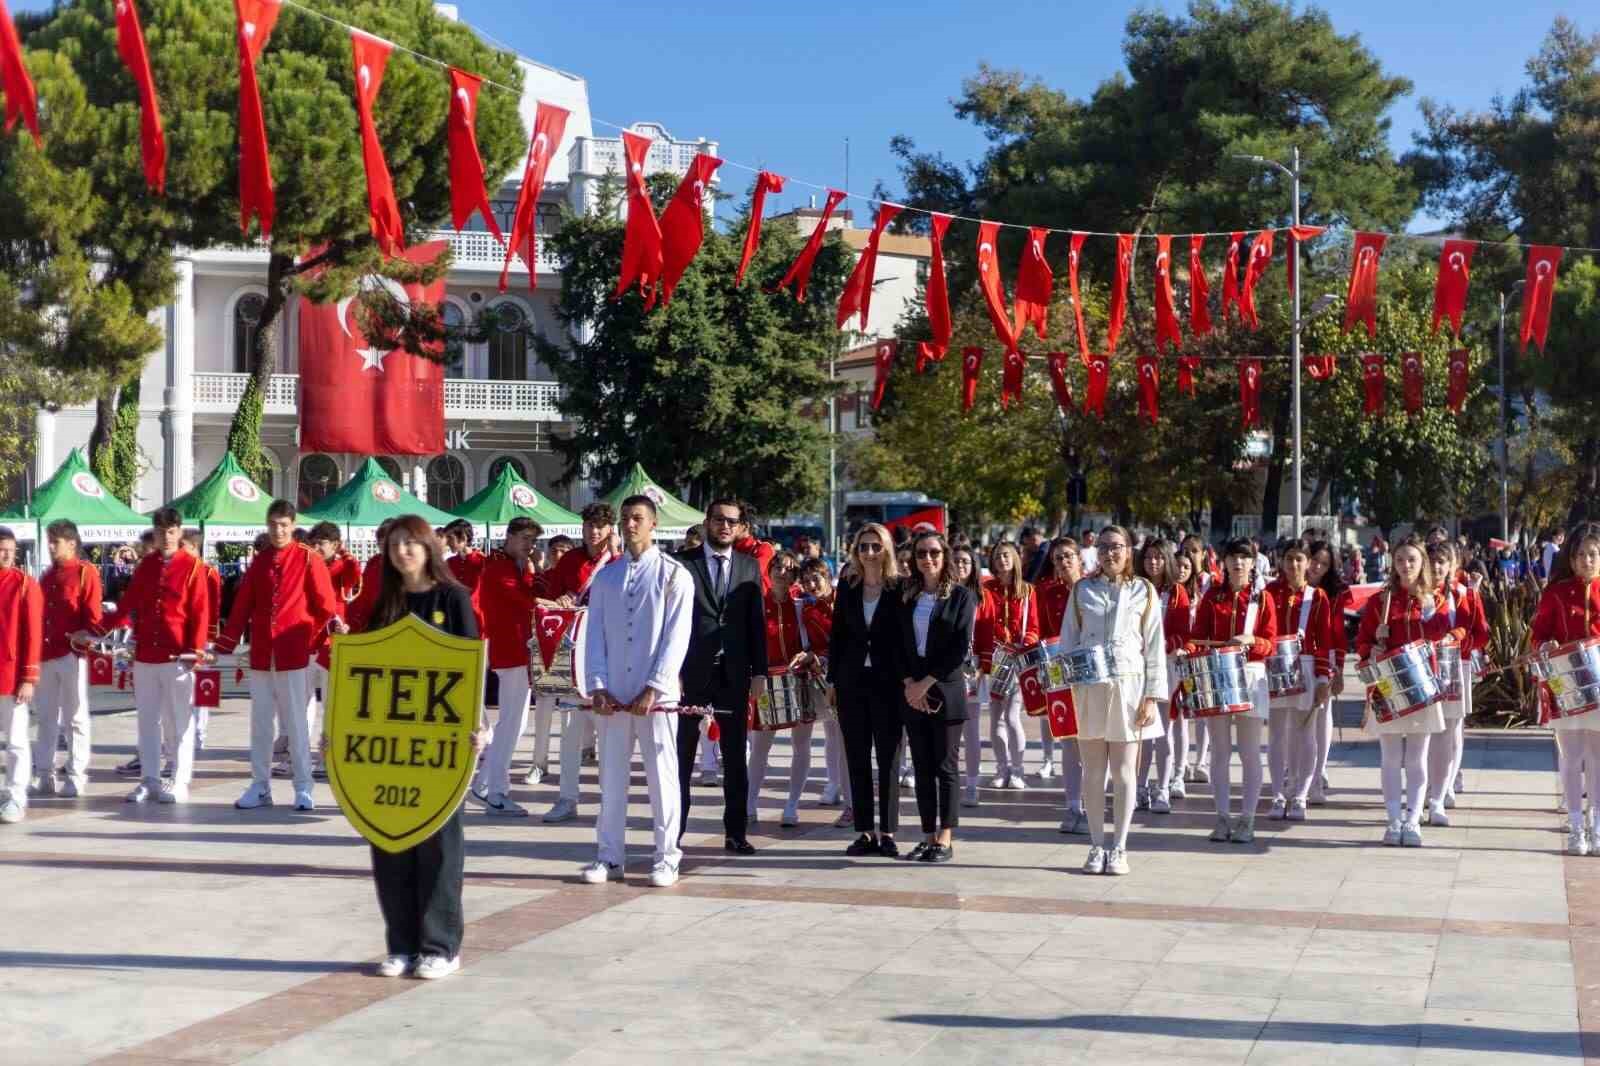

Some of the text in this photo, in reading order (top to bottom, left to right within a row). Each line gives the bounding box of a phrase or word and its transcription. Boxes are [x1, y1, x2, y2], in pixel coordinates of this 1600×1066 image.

[350, 667, 464, 723] TEK
[344, 733, 458, 769] KOLEJİ
[374, 785, 421, 807] 2012
